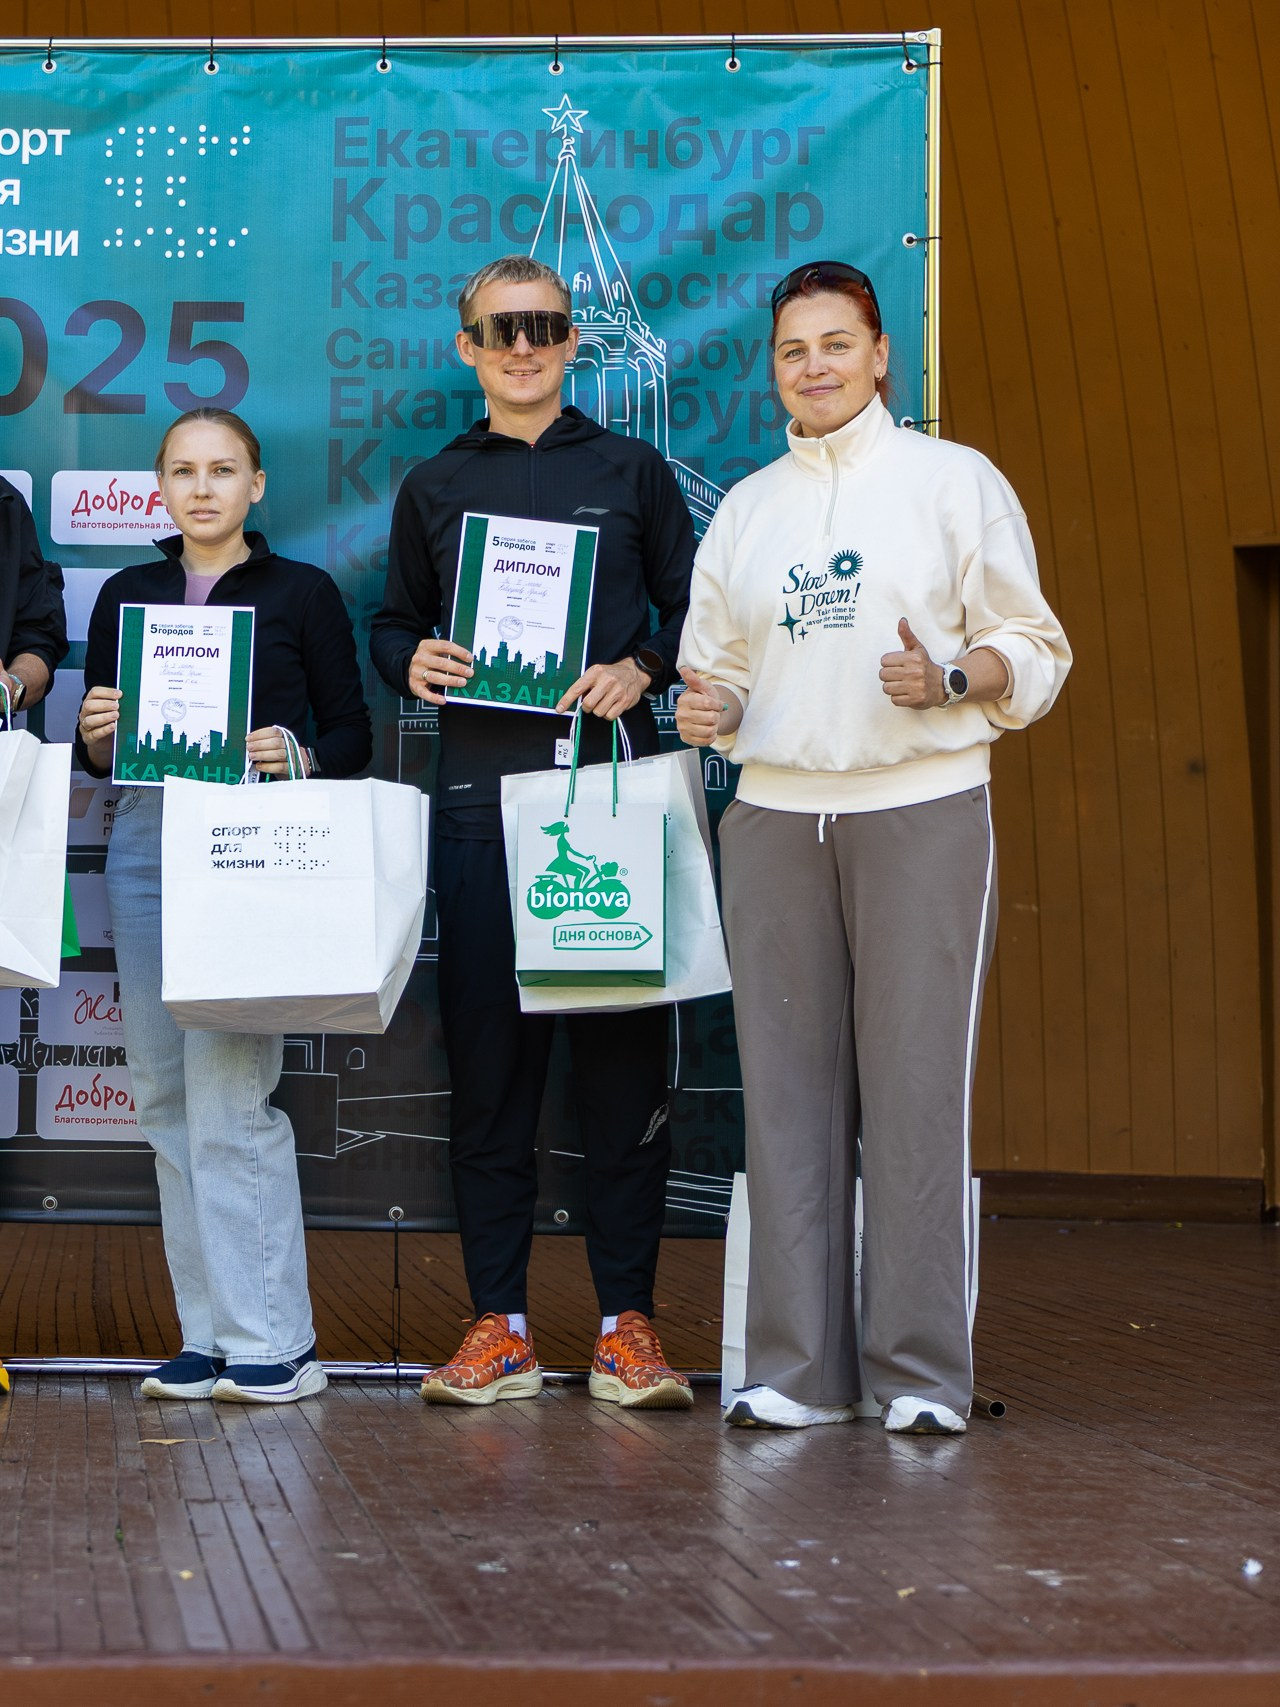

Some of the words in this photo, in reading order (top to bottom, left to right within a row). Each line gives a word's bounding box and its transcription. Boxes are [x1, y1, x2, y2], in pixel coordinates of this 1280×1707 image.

[332, 116, 826, 181] Екатеринбург
[331, 177, 825, 261] Краснодар
[330, 261, 470, 310] Каза
[579, 261, 774, 310] Москв
[71, 478, 171, 516] ДоброF
[70, 520, 161, 530] Благотворительная
[500, 541, 536, 551] городов
[493, 559, 561, 578] ДИПЛОМ
[782, 563, 828, 594] Slow
[158, 628, 194, 636] городов
[153, 646, 220, 659] ДИПЛОМ
[453, 680, 564, 708] КАЗАН
[211, 826, 261, 839] спорт
[210, 843, 243, 855] для
[210, 859, 265, 869] жизни
[529, 884, 629, 909] bionova
[558, 930, 586, 943] ДНЯ
[588, 929, 642, 942] ОСНОВА
[54, 1073, 136, 1112] Добро
[54, 1115, 138, 1126] Благотворительна
